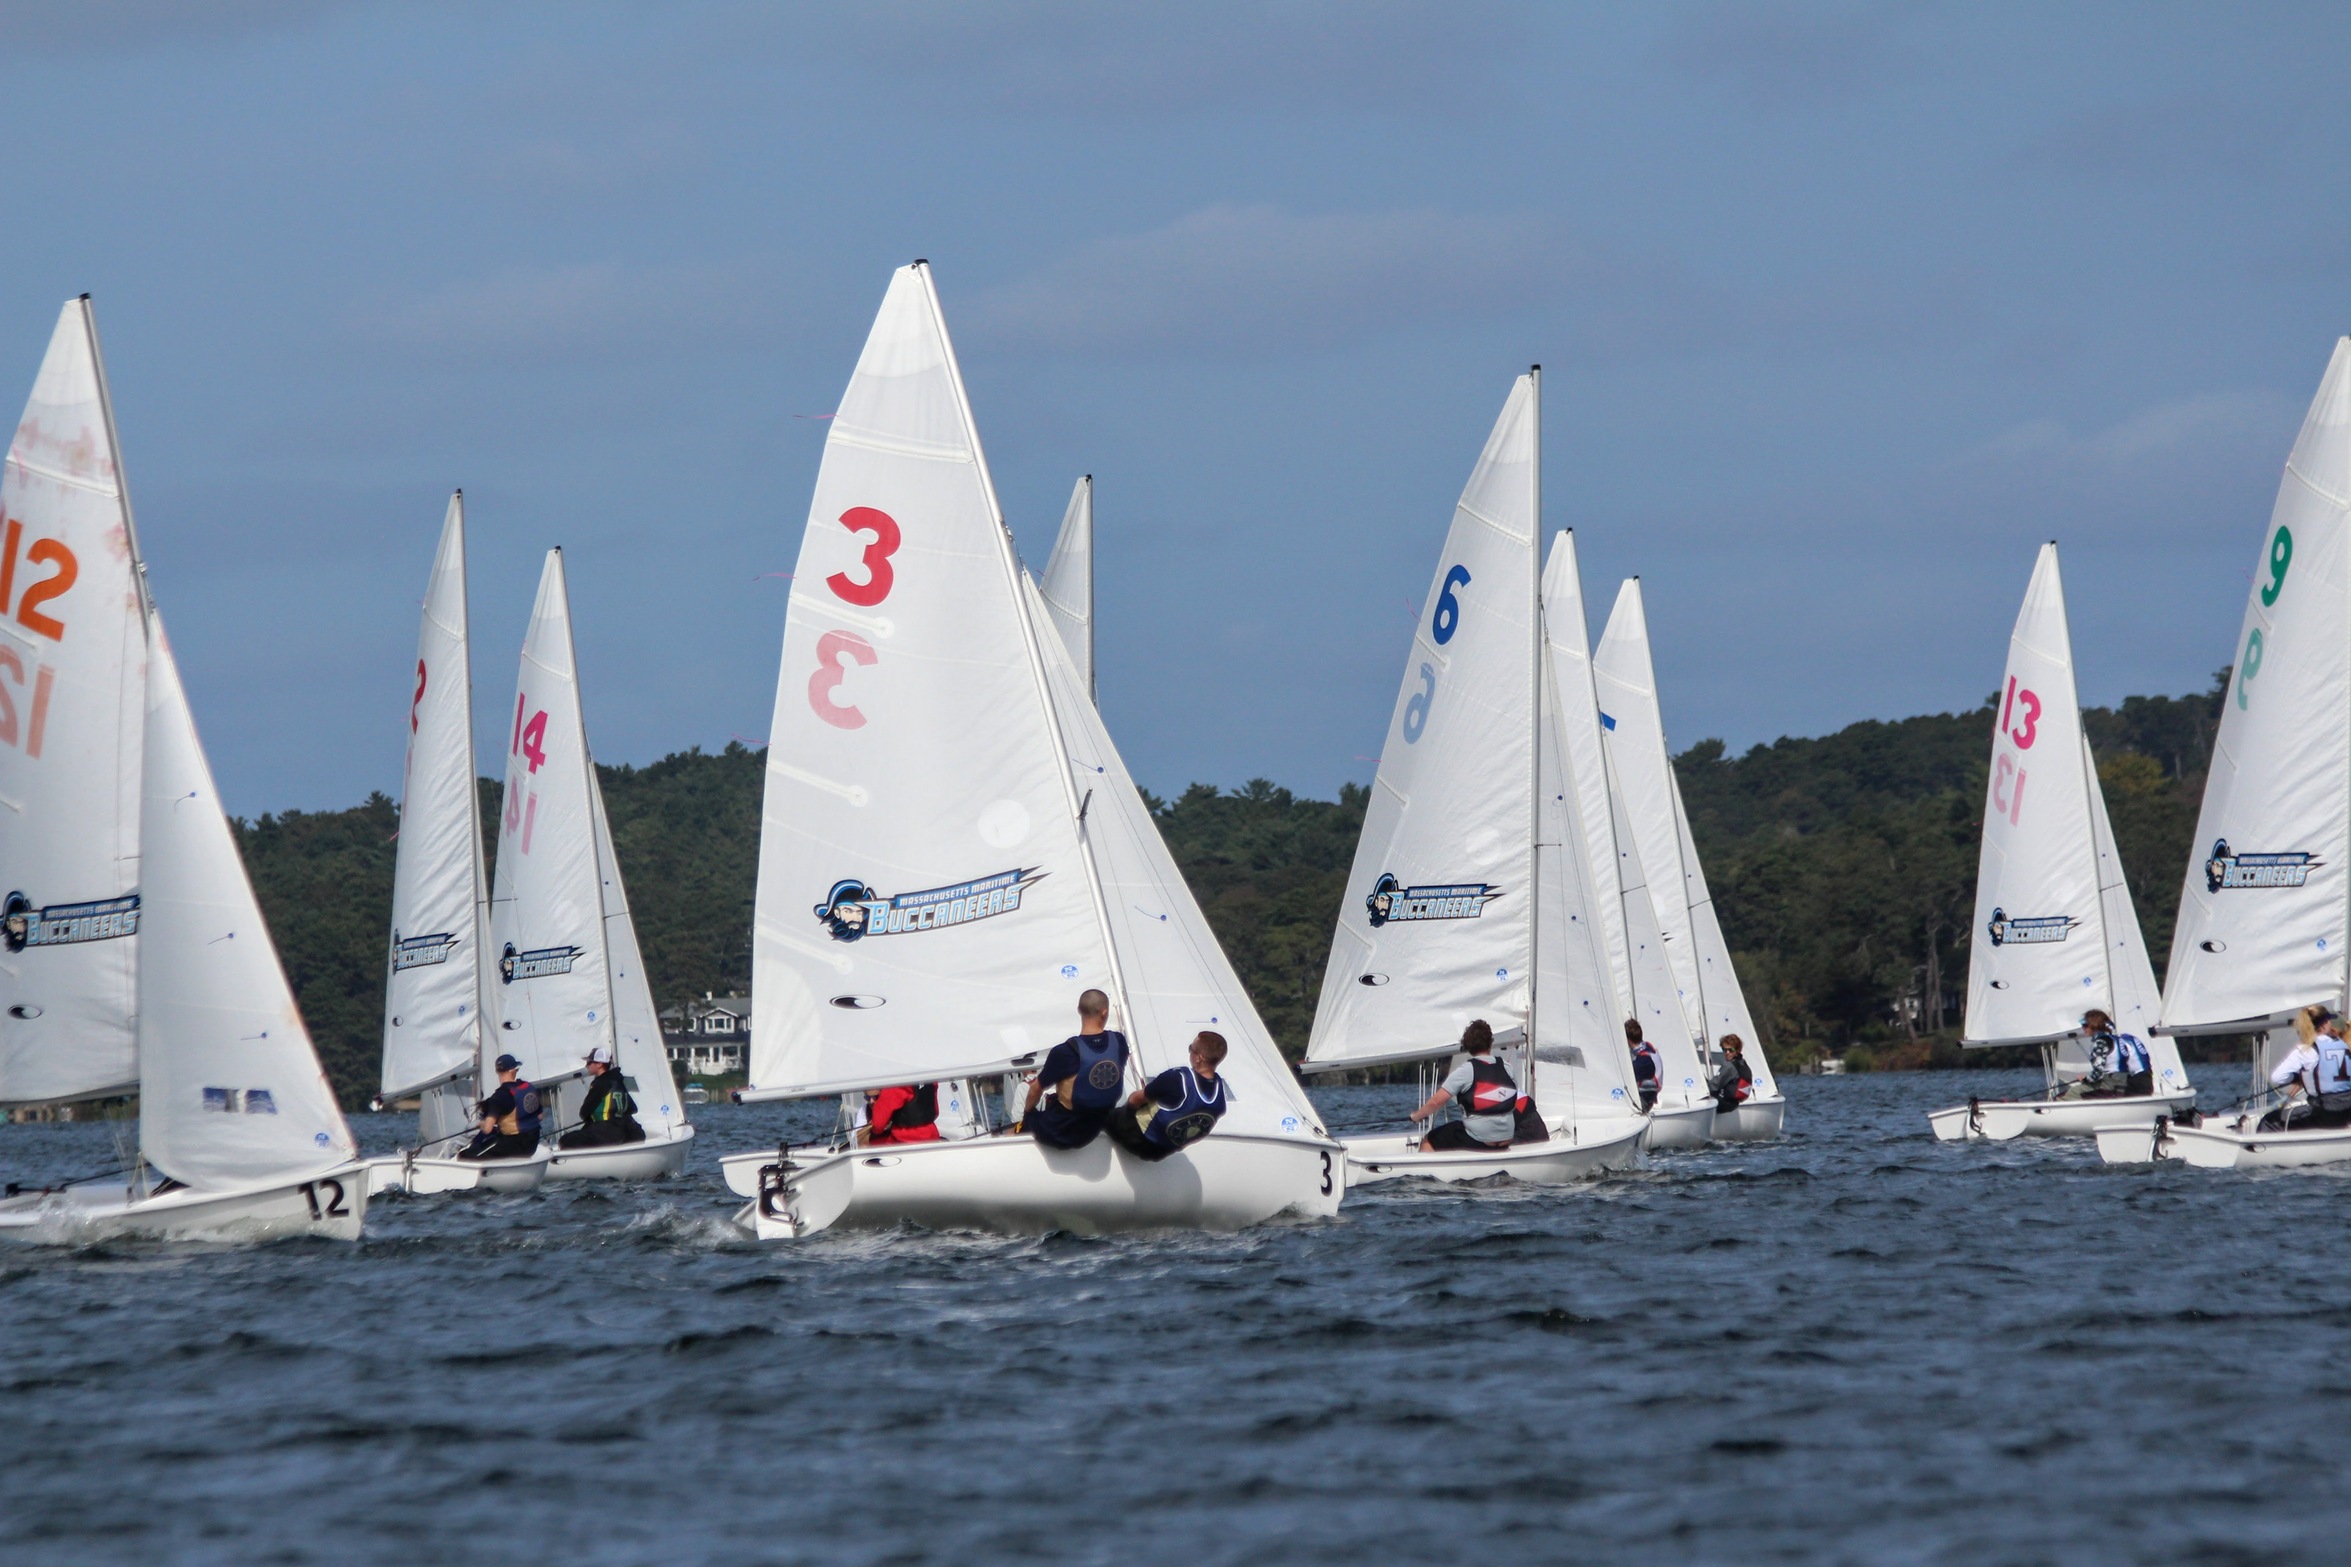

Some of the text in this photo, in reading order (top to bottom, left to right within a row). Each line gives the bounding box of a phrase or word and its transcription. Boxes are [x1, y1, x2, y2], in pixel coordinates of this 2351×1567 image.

[0, 518, 78, 643] 12
[826, 506, 902, 607] 3
[2261, 525, 2293, 607] 9
[1433, 564, 1472, 645] 6
[513, 691, 549, 775] 14
[2002, 674, 2042, 750] 13
[862, 881, 1030, 935] BUCCANEERS
[899, 874, 1015, 907] MASSACHUSETTS MARITIME
[298, 1179, 350, 1221] 12
[1320, 1150, 1334, 1197] 3
